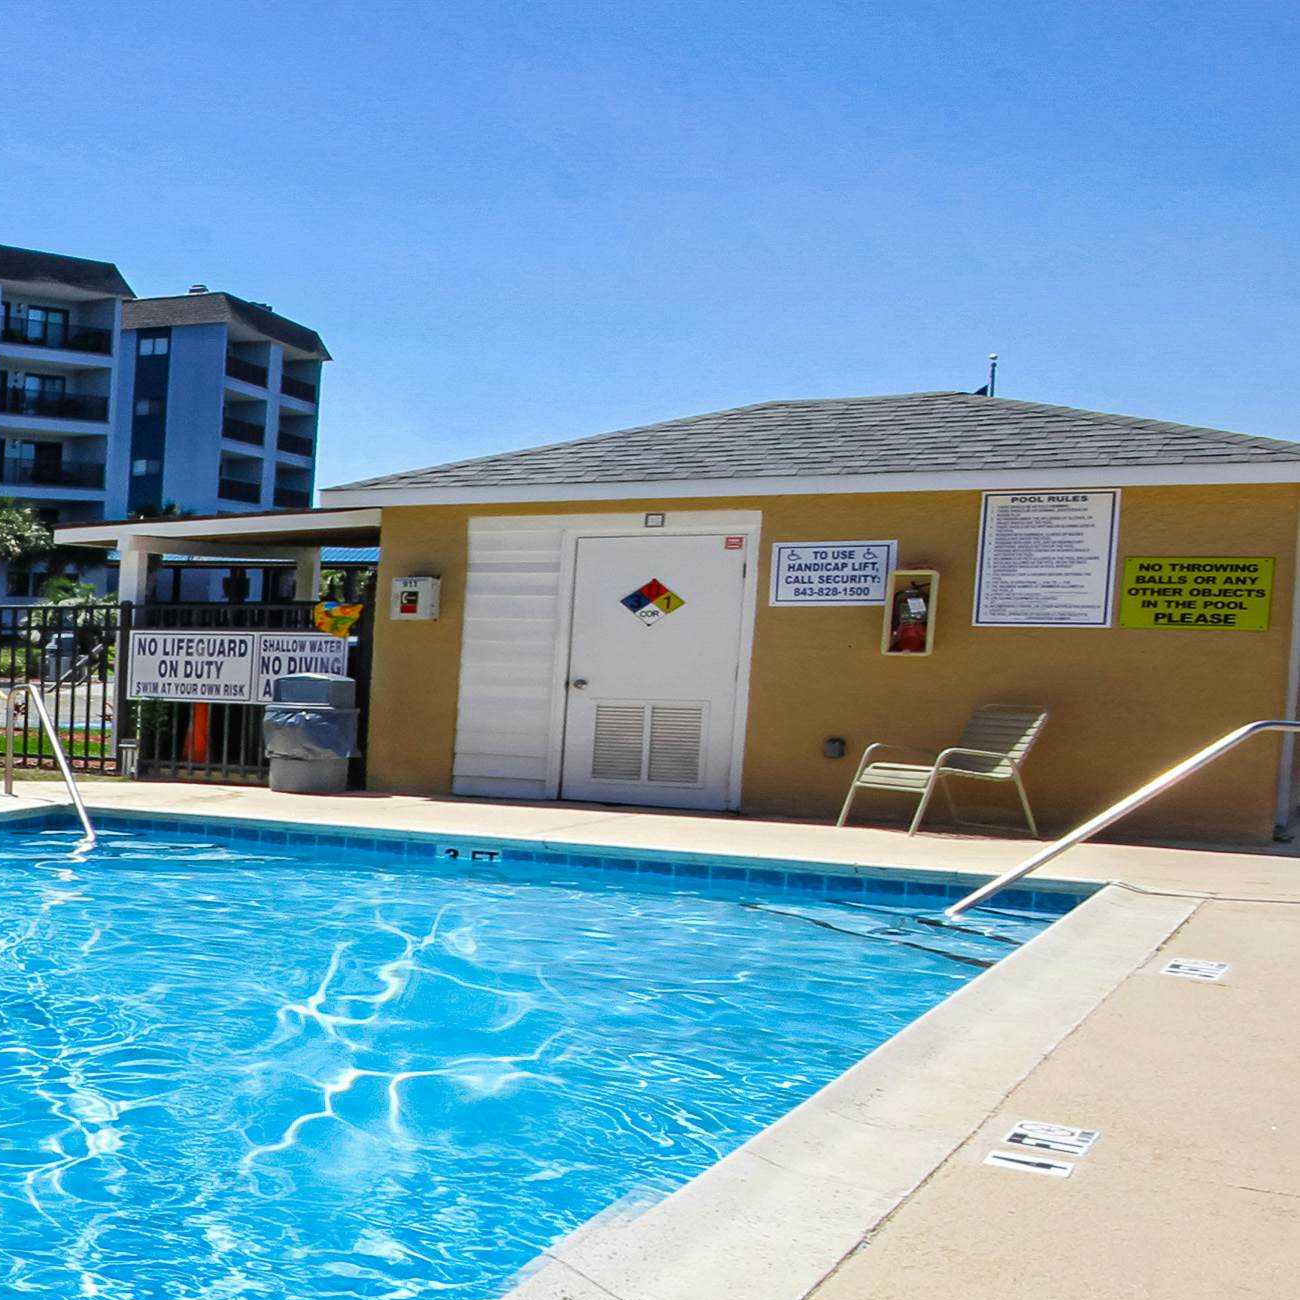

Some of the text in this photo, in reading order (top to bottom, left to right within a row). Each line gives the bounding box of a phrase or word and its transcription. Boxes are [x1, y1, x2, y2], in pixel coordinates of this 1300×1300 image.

[1047, 495, 1089, 503] RULES
[813, 550, 855, 560] TO USE
[787, 562, 879, 572] HANDICAP LIFT,
[1139, 563, 1259, 573] NO THROWING
[785, 574, 881, 585] CALL SECURITY:
[1135, 576, 1259, 585] BALLS OR ANY
[793, 587, 870, 597] 843-828-1500
[1128, 588, 1266, 598] OTHER OBJECTS
[1142, 600, 1248, 610] IN THE POOL
[1154, 612, 1237, 625] PLEASE
[137, 638, 249, 657] NO LIFEGUARD
[262, 639, 343, 652] SHALLOW WATER
[158, 660, 225, 679] ON DUTY
[261, 656, 342, 675] NO DIVING
[136, 682, 245, 696] SWIM AT YOUR OWN RISK
[992, 1132, 1084, 1170] 4 FT
